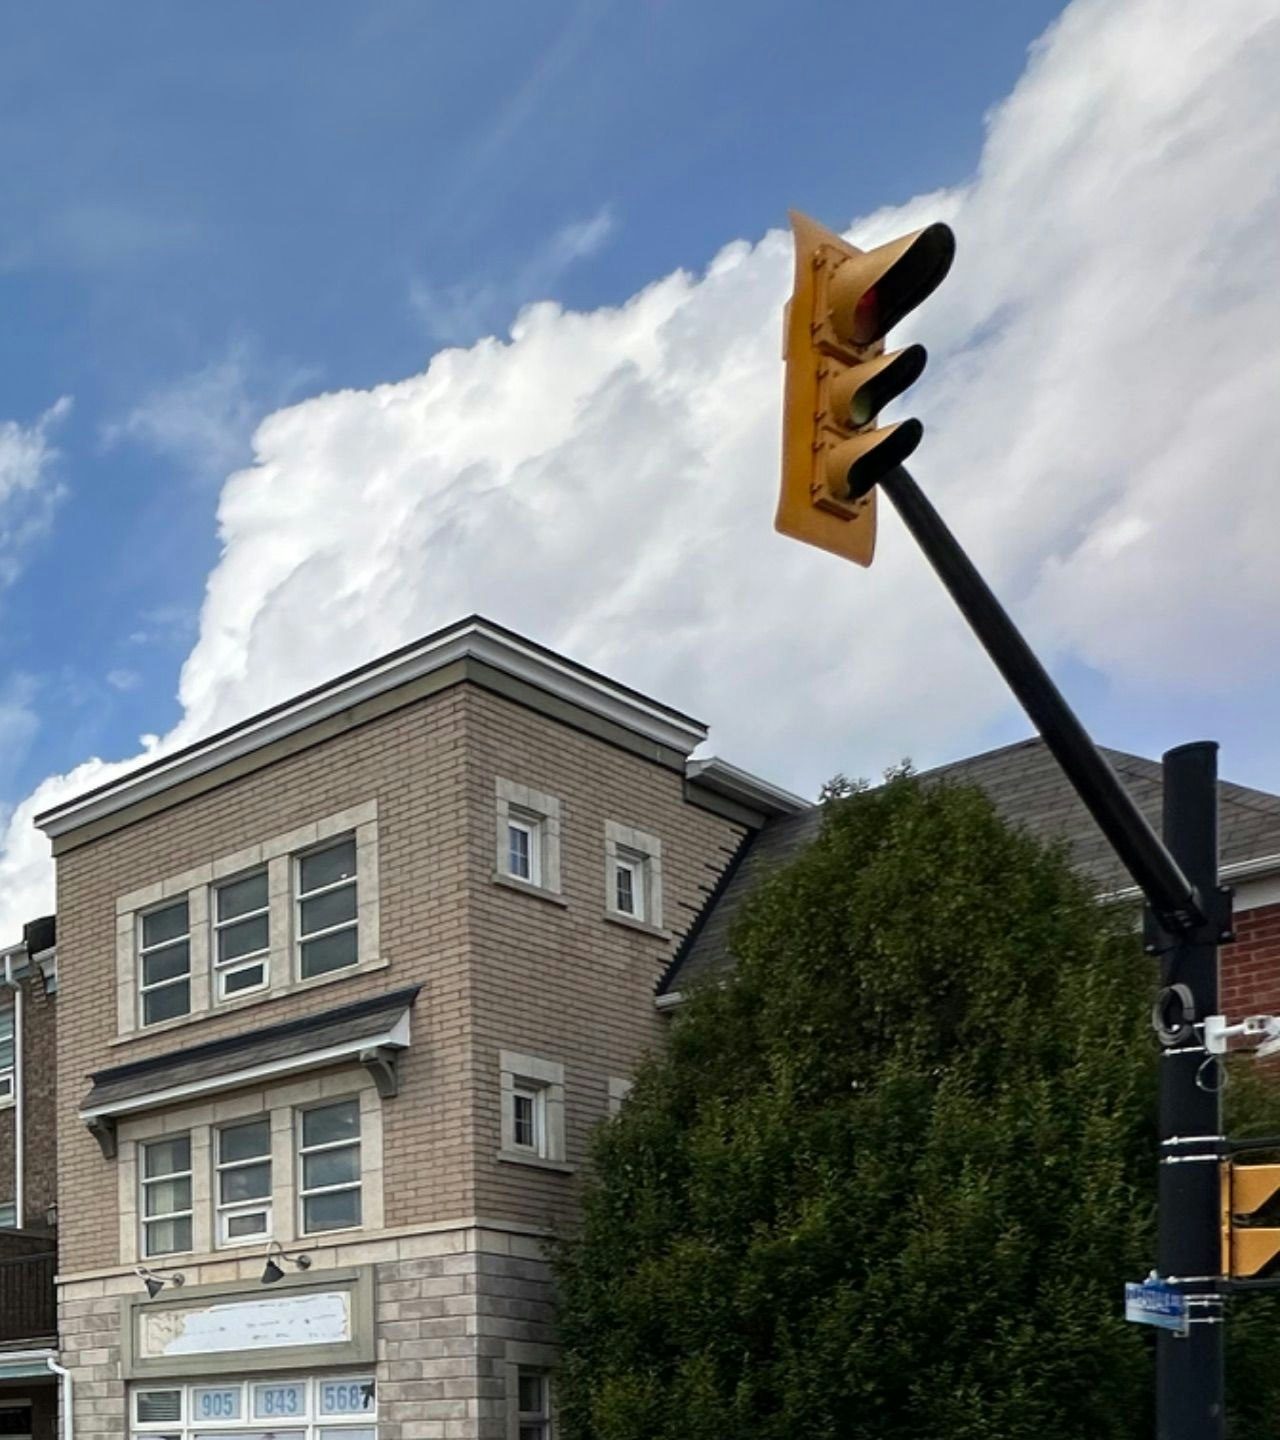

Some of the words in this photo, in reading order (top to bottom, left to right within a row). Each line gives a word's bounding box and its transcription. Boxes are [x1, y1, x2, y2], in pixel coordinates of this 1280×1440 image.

[201, 1392, 234, 1417] 905
[263, 1388, 298, 1414] 843
[325, 1384, 370, 1411] 568
